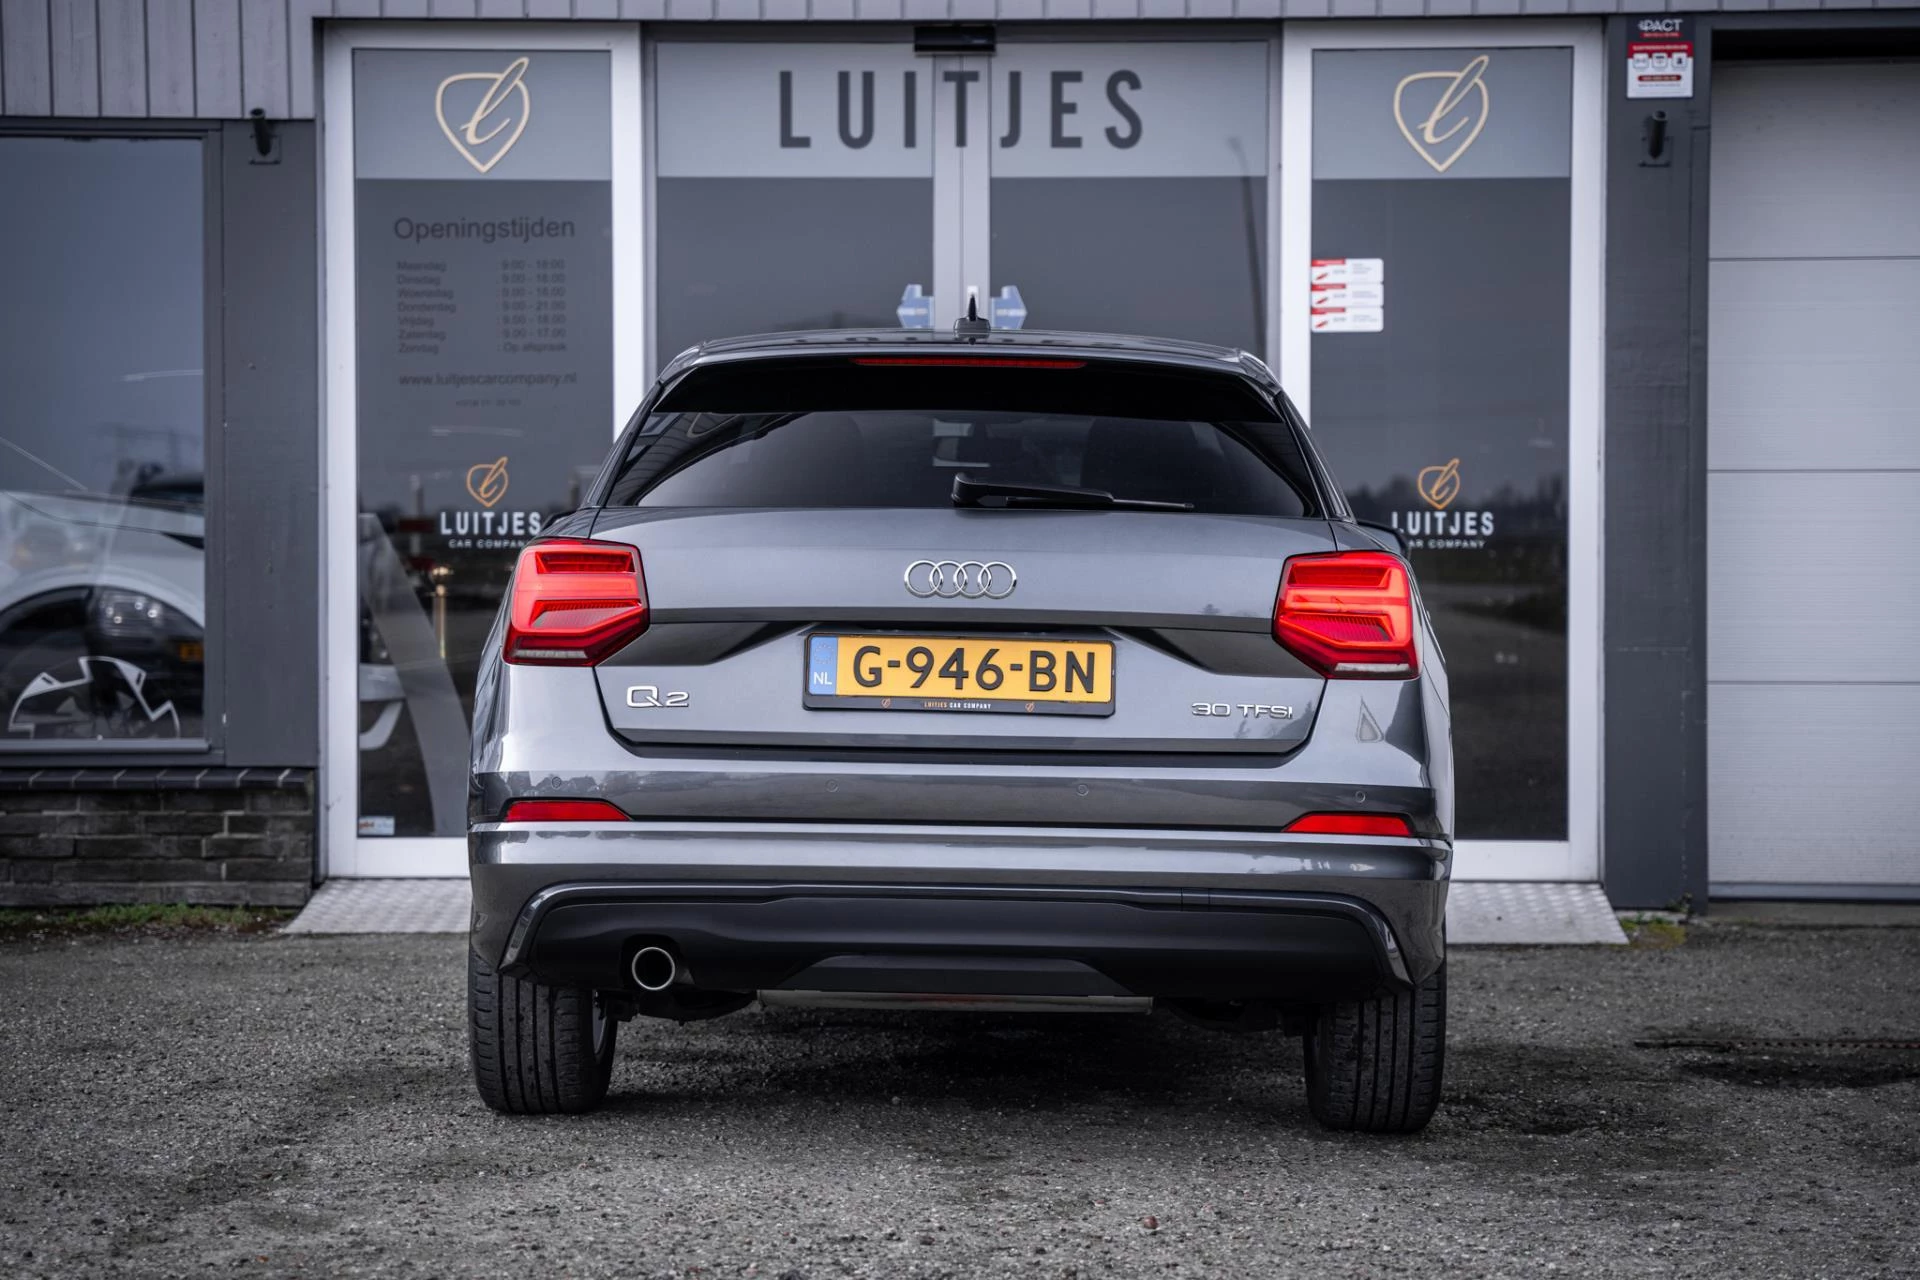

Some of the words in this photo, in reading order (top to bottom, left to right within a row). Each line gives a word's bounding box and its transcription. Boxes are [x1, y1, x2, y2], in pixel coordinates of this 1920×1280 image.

[779, 69, 1143, 150] LUITJES
[394, 216, 576, 244] Openingstijden
[399, 372, 577, 388] www.luitjescarcompany.nl
[440, 511, 541, 535] LUITJES
[1391, 511, 1494, 536] LUITJES
[448, 538, 472, 549] CAR
[476, 538, 526, 549] COMPAN
[1407, 538, 1424, 549] AR
[1427, 538, 1486, 549] COMPANY
[813, 671, 833, 685] NL
[853, 645, 1095, 694] G-946-BN
[626, 685, 689, 708] Q2
[963, 702, 992, 710] COMPANY
[1191, 702, 1231, 717] 30
[1236, 703, 1293, 719] TFSI
